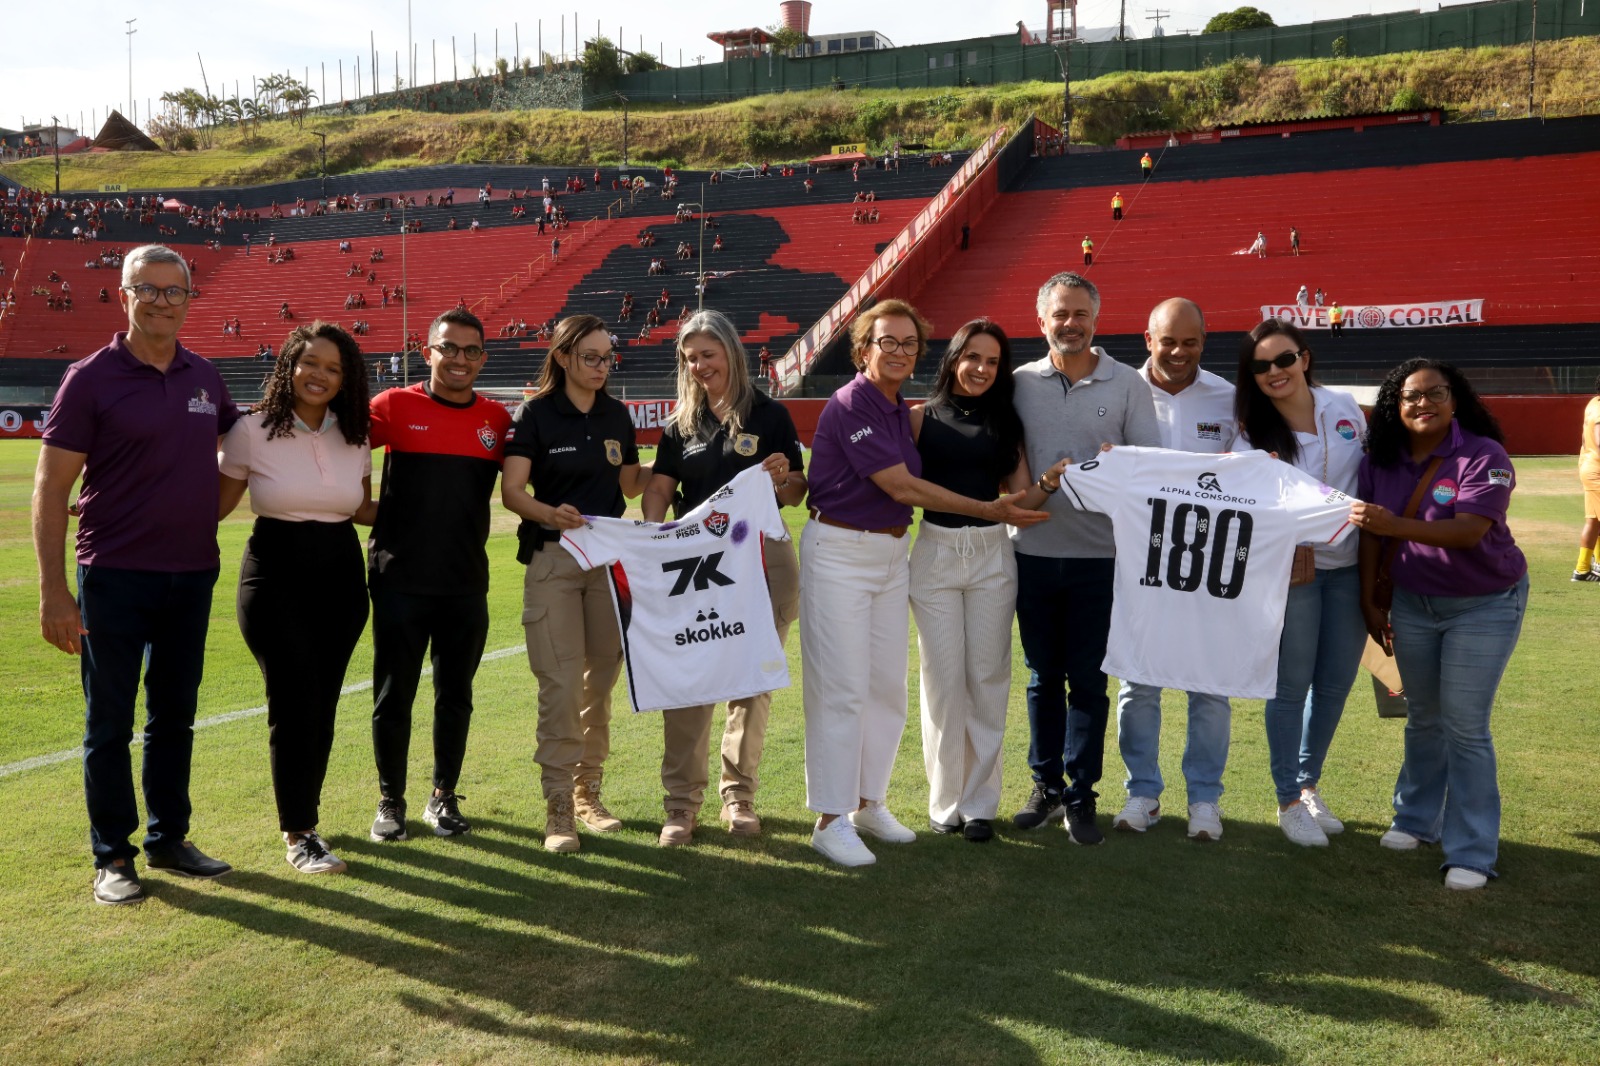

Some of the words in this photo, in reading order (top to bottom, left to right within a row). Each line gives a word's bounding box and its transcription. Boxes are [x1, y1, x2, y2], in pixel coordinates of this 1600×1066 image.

[839, 145, 857, 154] BAR
[1389, 303, 1478, 327] CORAL
[850, 426, 873, 443] SPM
[549, 446, 577, 454] DELEGADA
[1160, 486, 1191, 496] ALPHA
[1194, 491, 1257, 505] CONSÓRCIO
[676, 527, 700, 539] PISOS
[1140, 498, 1254, 600] 180
[661, 551, 736, 597] 7K
[674, 621, 745, 646] skokka
